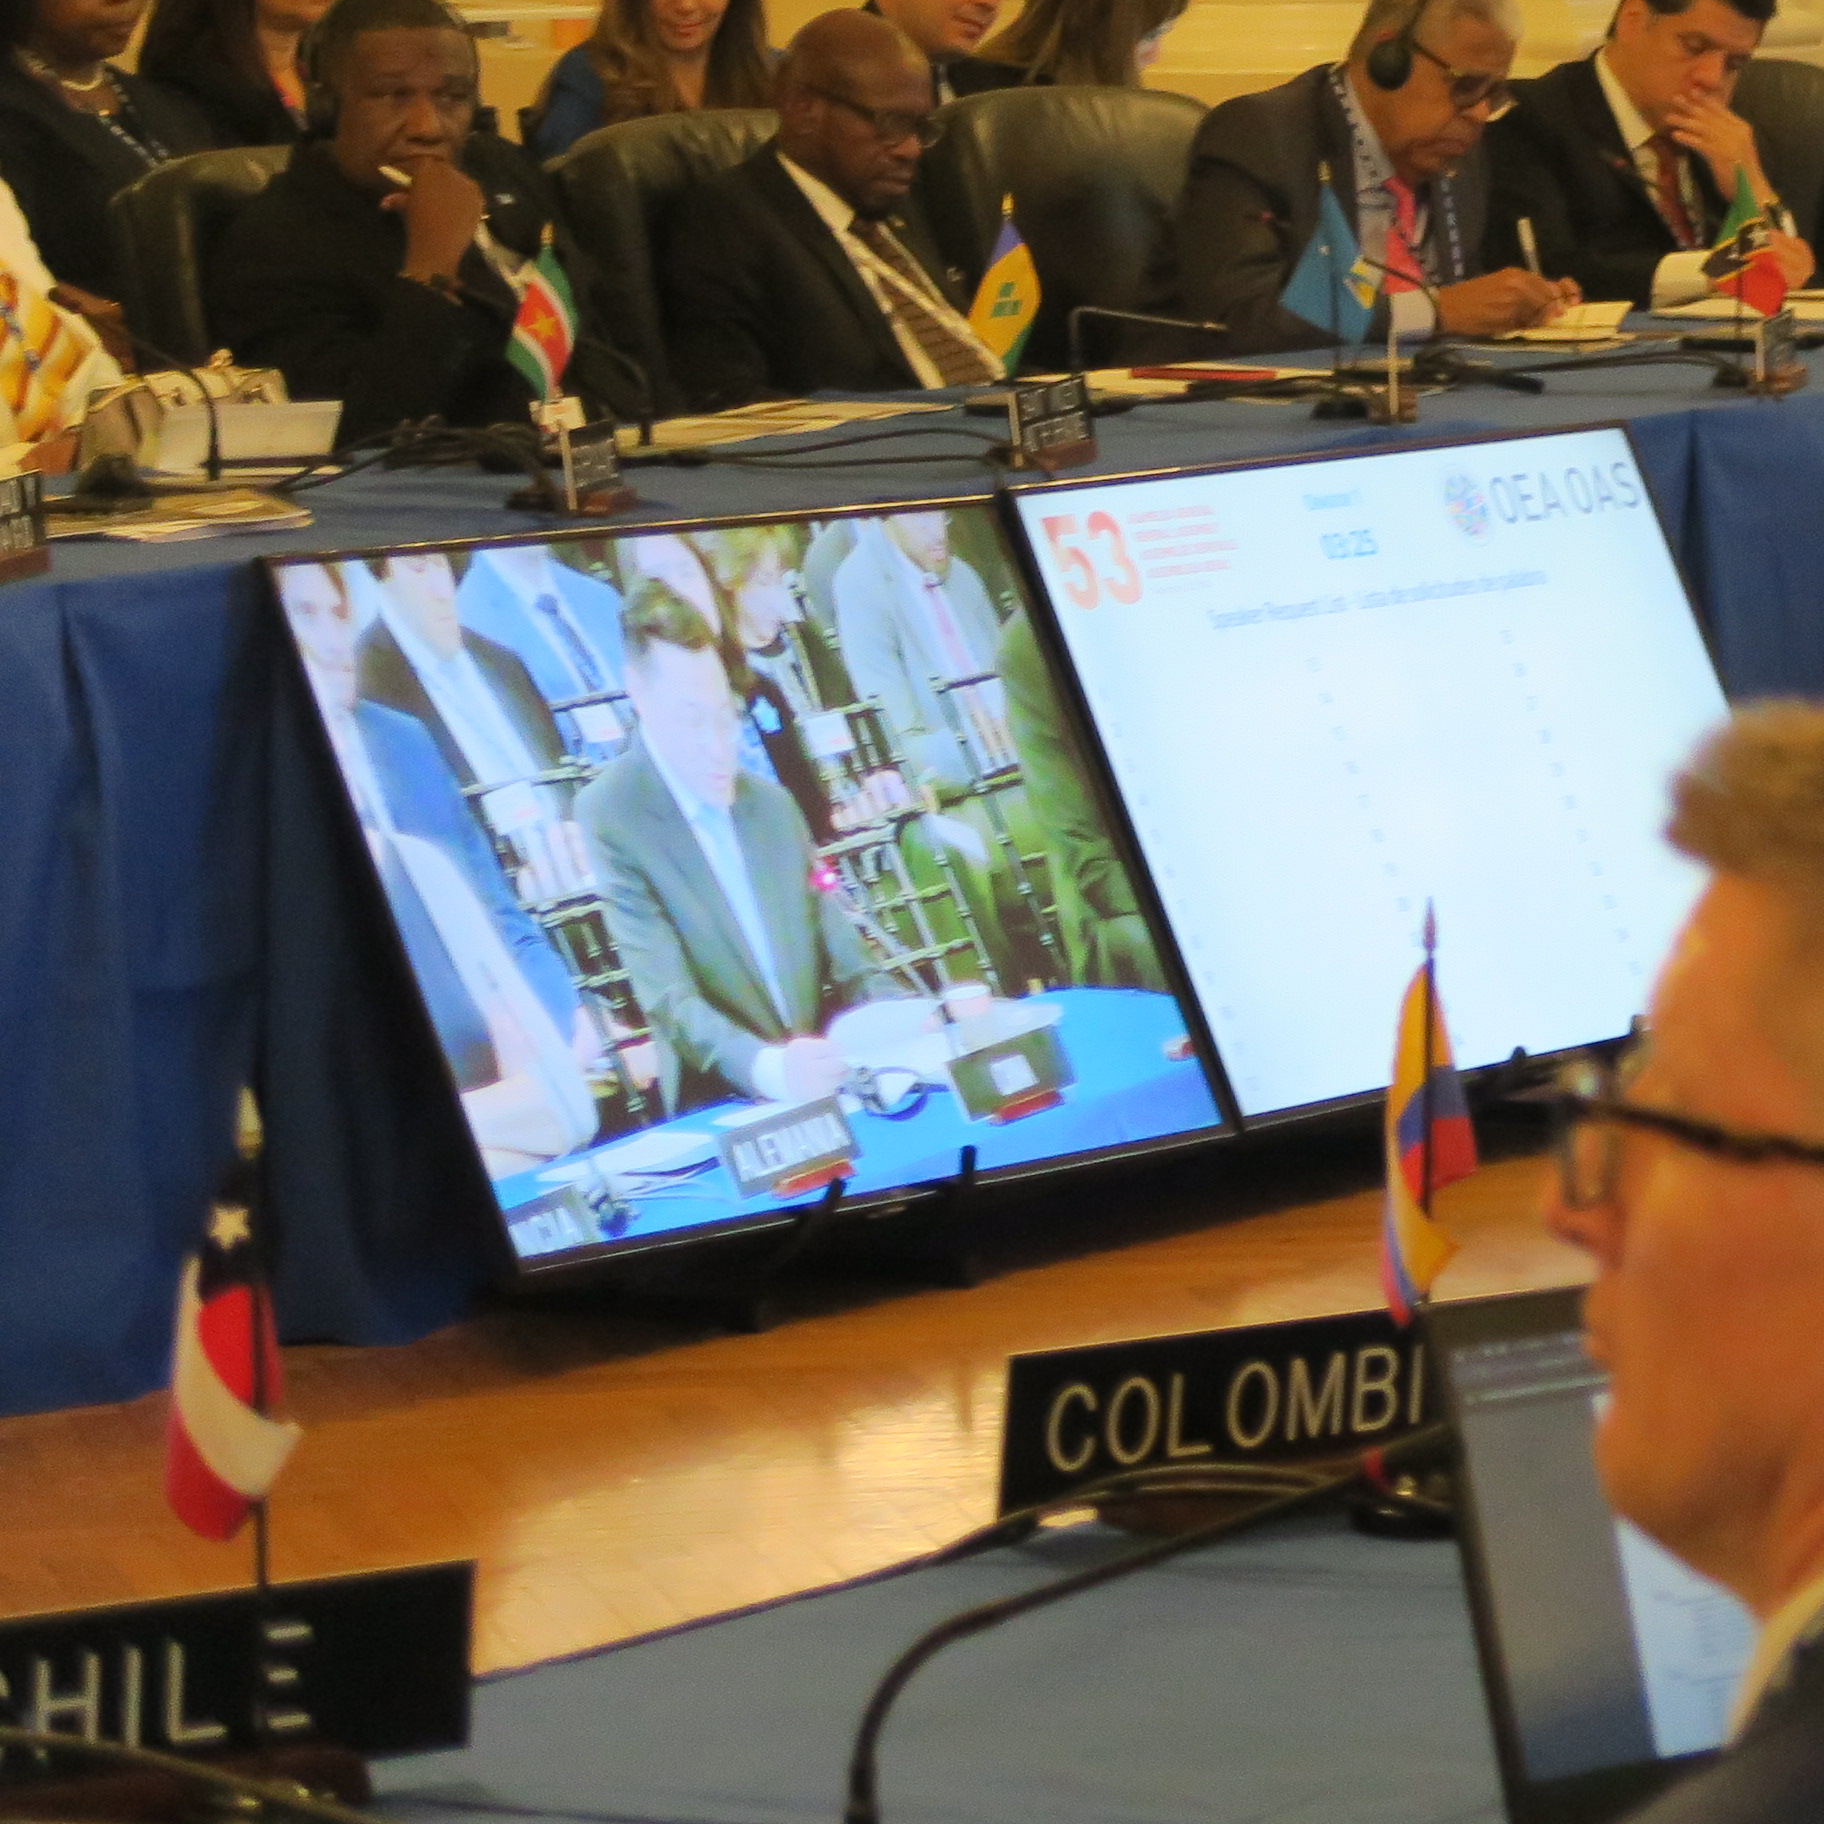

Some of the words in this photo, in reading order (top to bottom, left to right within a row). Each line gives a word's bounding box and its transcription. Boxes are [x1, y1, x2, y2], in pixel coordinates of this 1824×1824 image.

[1489, 473, 1563, 525] OEA
[1563, 461, 1641, 515] OAS
[1041, 510, 1142, 610] 53
[1046, 1343, 1426, 1473] COLOMBI
[0, 1622, 312, 1756] HILE
